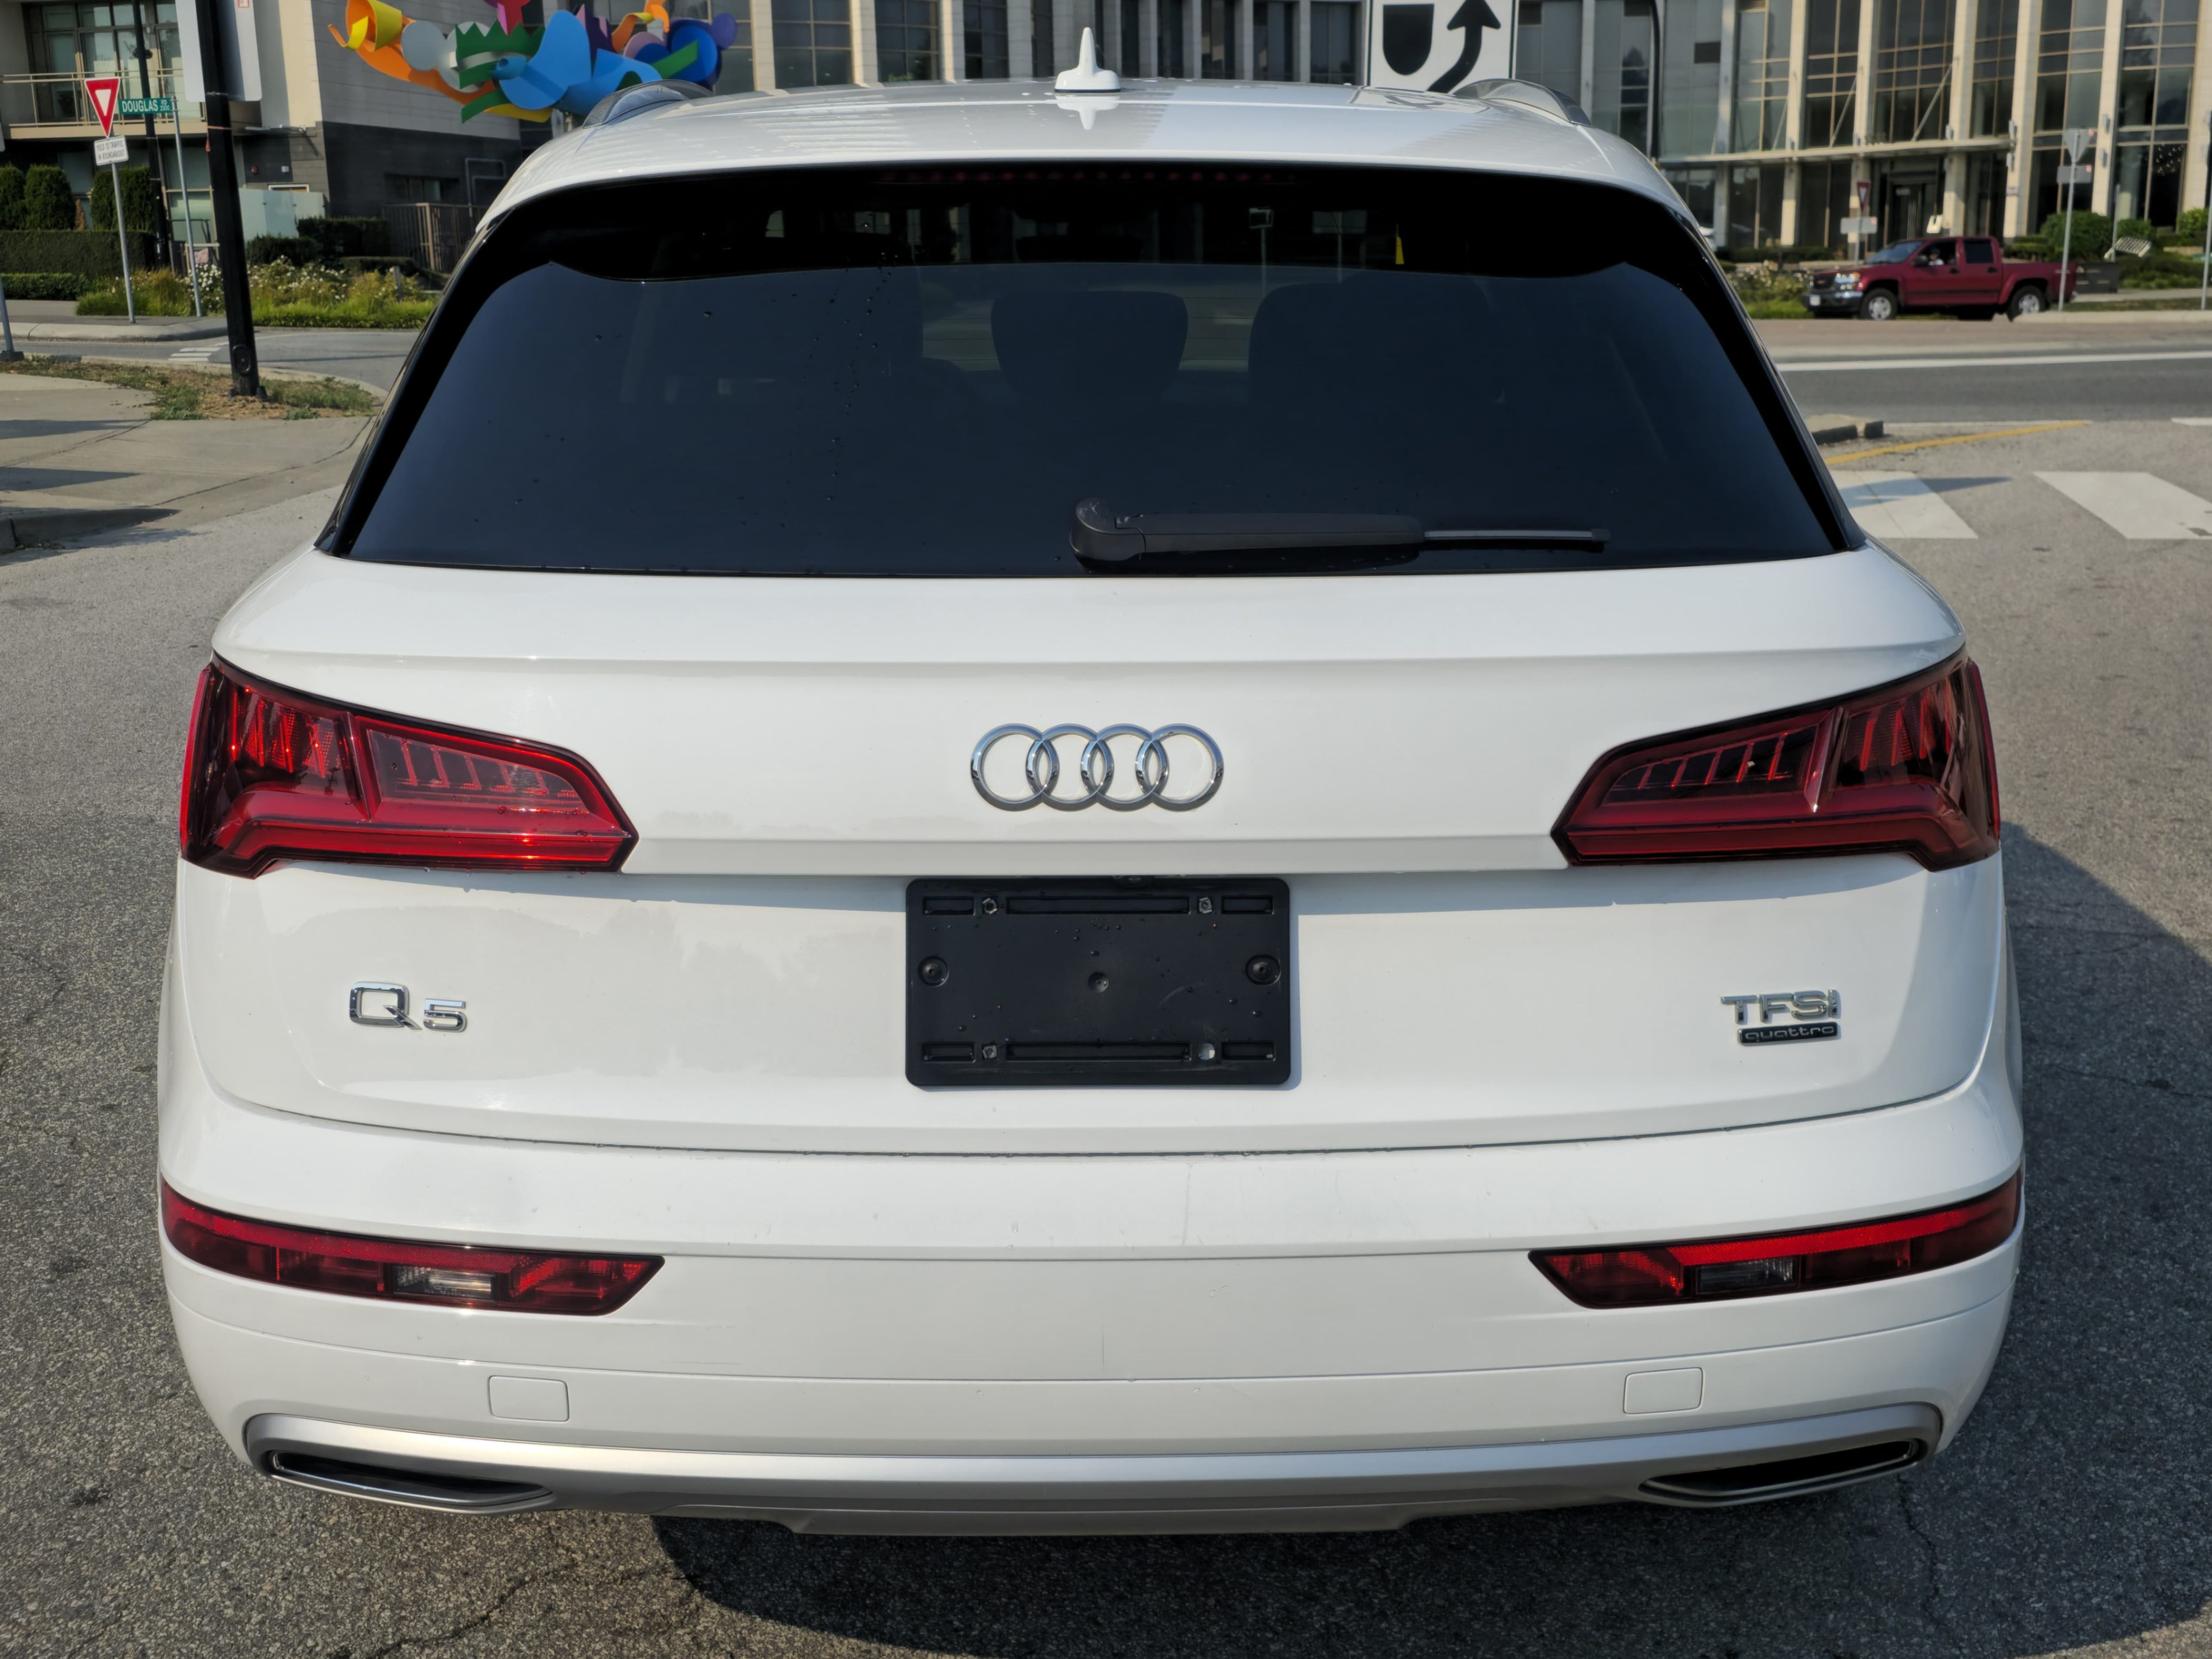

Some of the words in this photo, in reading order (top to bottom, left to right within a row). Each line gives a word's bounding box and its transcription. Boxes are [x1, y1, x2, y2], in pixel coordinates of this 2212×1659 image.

[122, 100, 158, 112] DOUGLAS
[103, 150, 125, 159] ROUNDABOUT
[349, 981, 467, 1033] Q5
[1721, 989, 1839, 1023] TFSI
[1745, 1026, 1834, 1042] quattro
